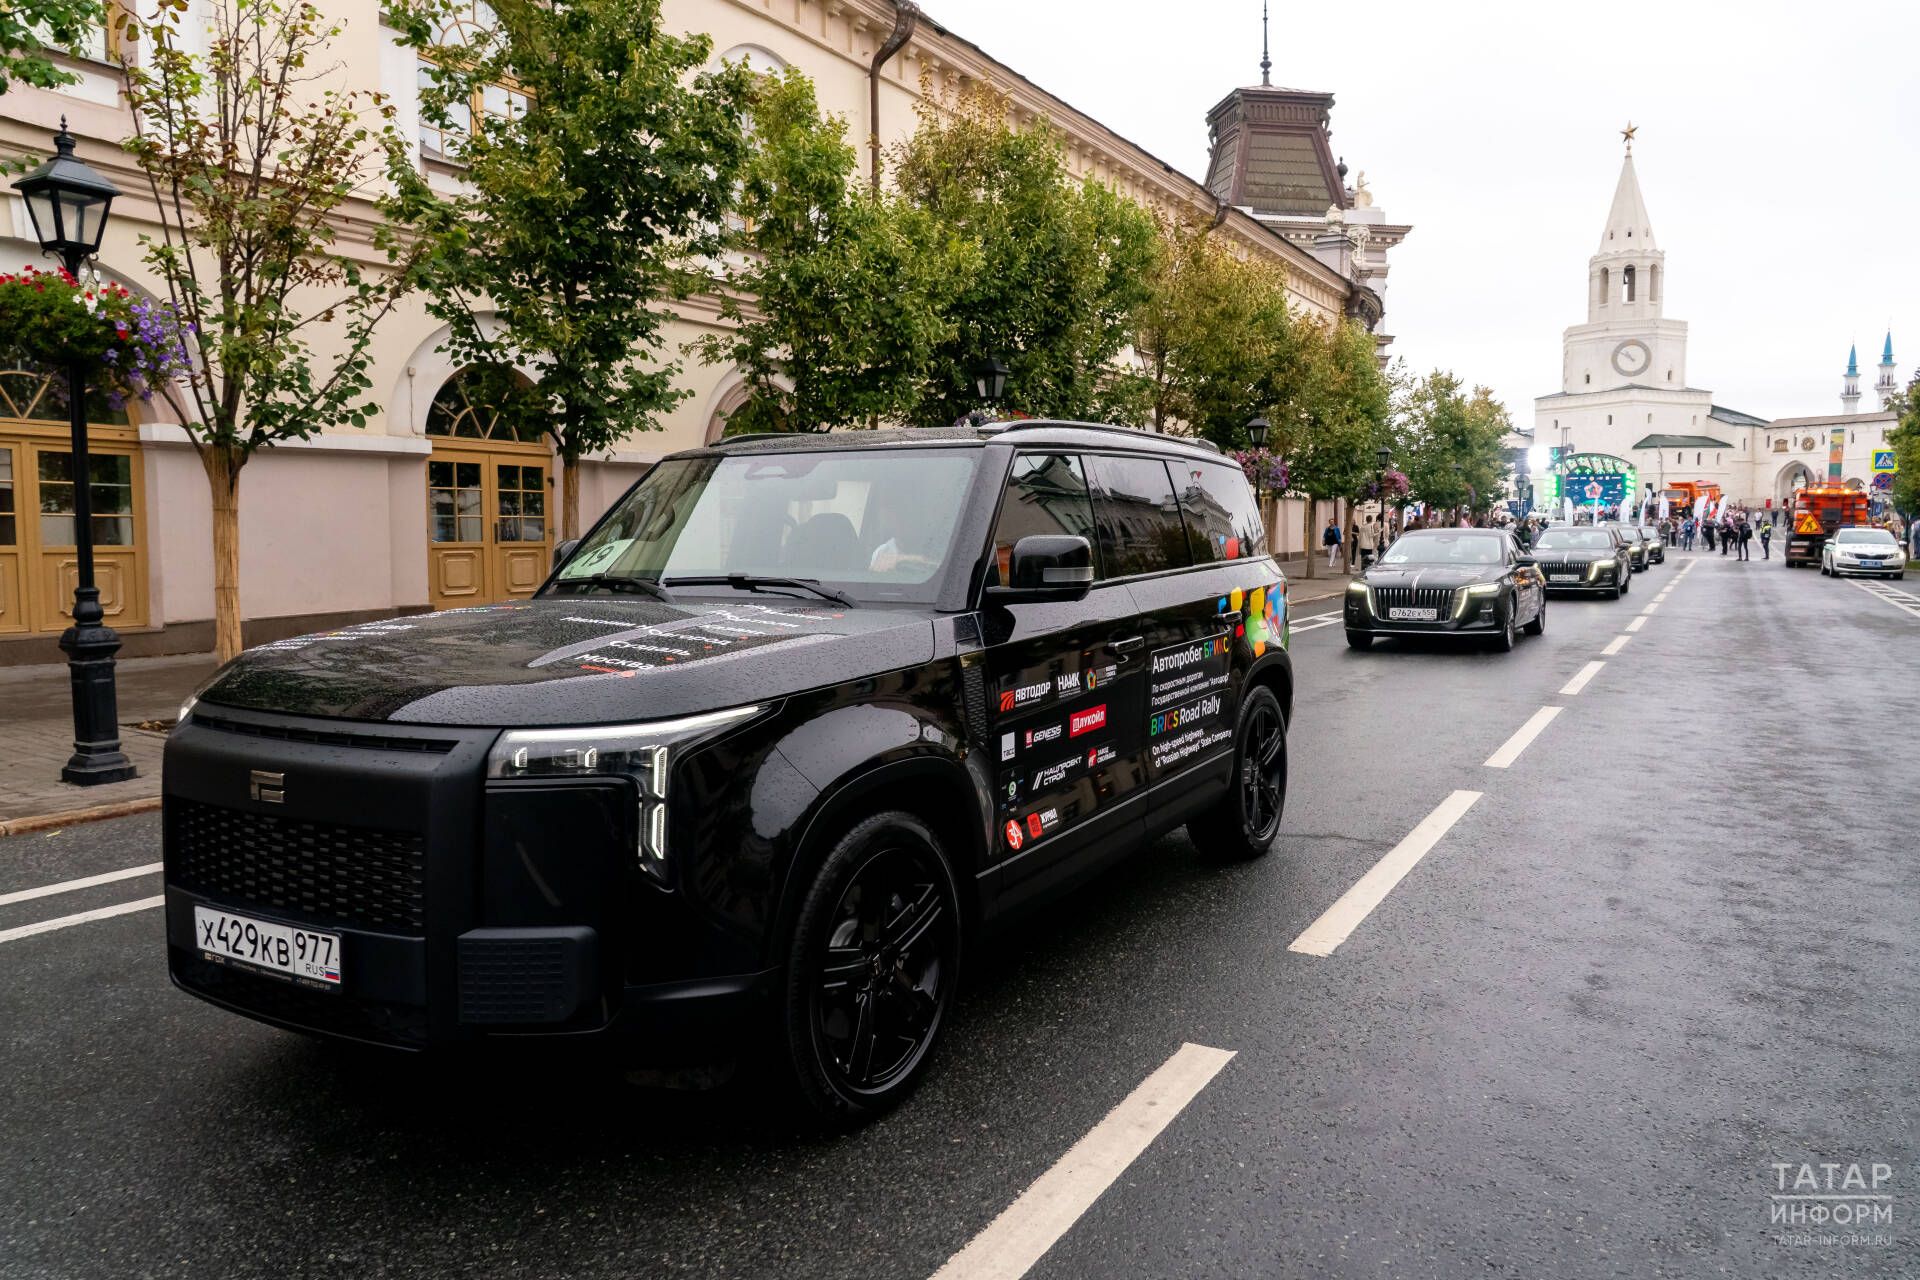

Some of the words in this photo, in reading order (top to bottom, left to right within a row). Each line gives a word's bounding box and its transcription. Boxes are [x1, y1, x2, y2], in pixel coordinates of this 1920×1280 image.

[581, 545, 615, 568] 19
[574, 654, 656, 670] Москва
[1152, 646, 1203, 675] Автопробег
[1203, 637, 1229, 659] БРИКС
[1015, 681, 1051, 702] АВТОДОР
[1079, 711, 1105, 729] ЛУКОЙЛ
[1151, 710, 1179, 737] BRICS
[1179, 701, 1201, 726] Road
[1201, 695, 1221, 717] Rally
[1034, 725, 1062, 742] GENESIS
[1152, 745, 1160, 755] On
[1159, 734, 1185, 753] high-speed
[1155, 758, 1162, 768] of
[1201, 737, 1212, 748] State
[1211, 729, 1233, 742] Company
[1043, 756, 1083, 777] НАЦПРОЕКТ
[1043, 769, 1066, 786] СТРОЙ
[201, 916, 290, 967] Х429КВ
[295, 931, 333, 966] 977
[305, 963, 326, 977] RUS
